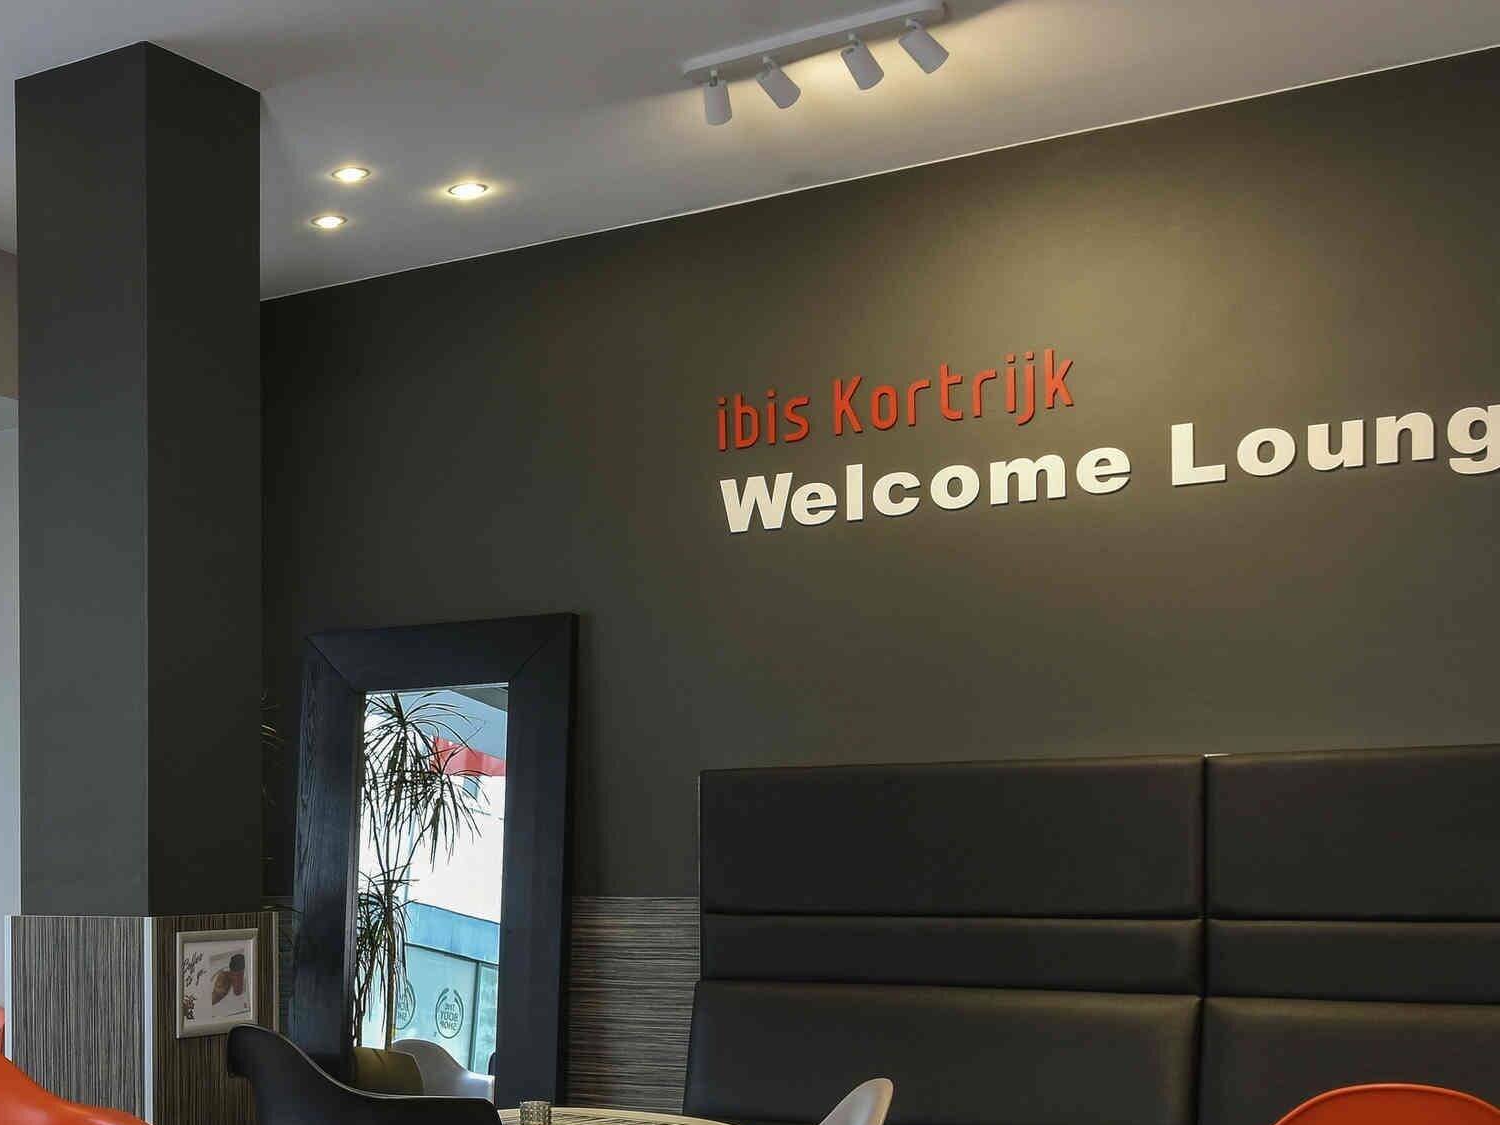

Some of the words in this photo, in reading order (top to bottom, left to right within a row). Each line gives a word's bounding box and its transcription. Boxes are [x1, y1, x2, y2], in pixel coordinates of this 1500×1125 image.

[716, 388, 811, 452] ibis
[832, 348, 1075, 436] Kortrijk
[719, 446, 1132, 534] Welcome
